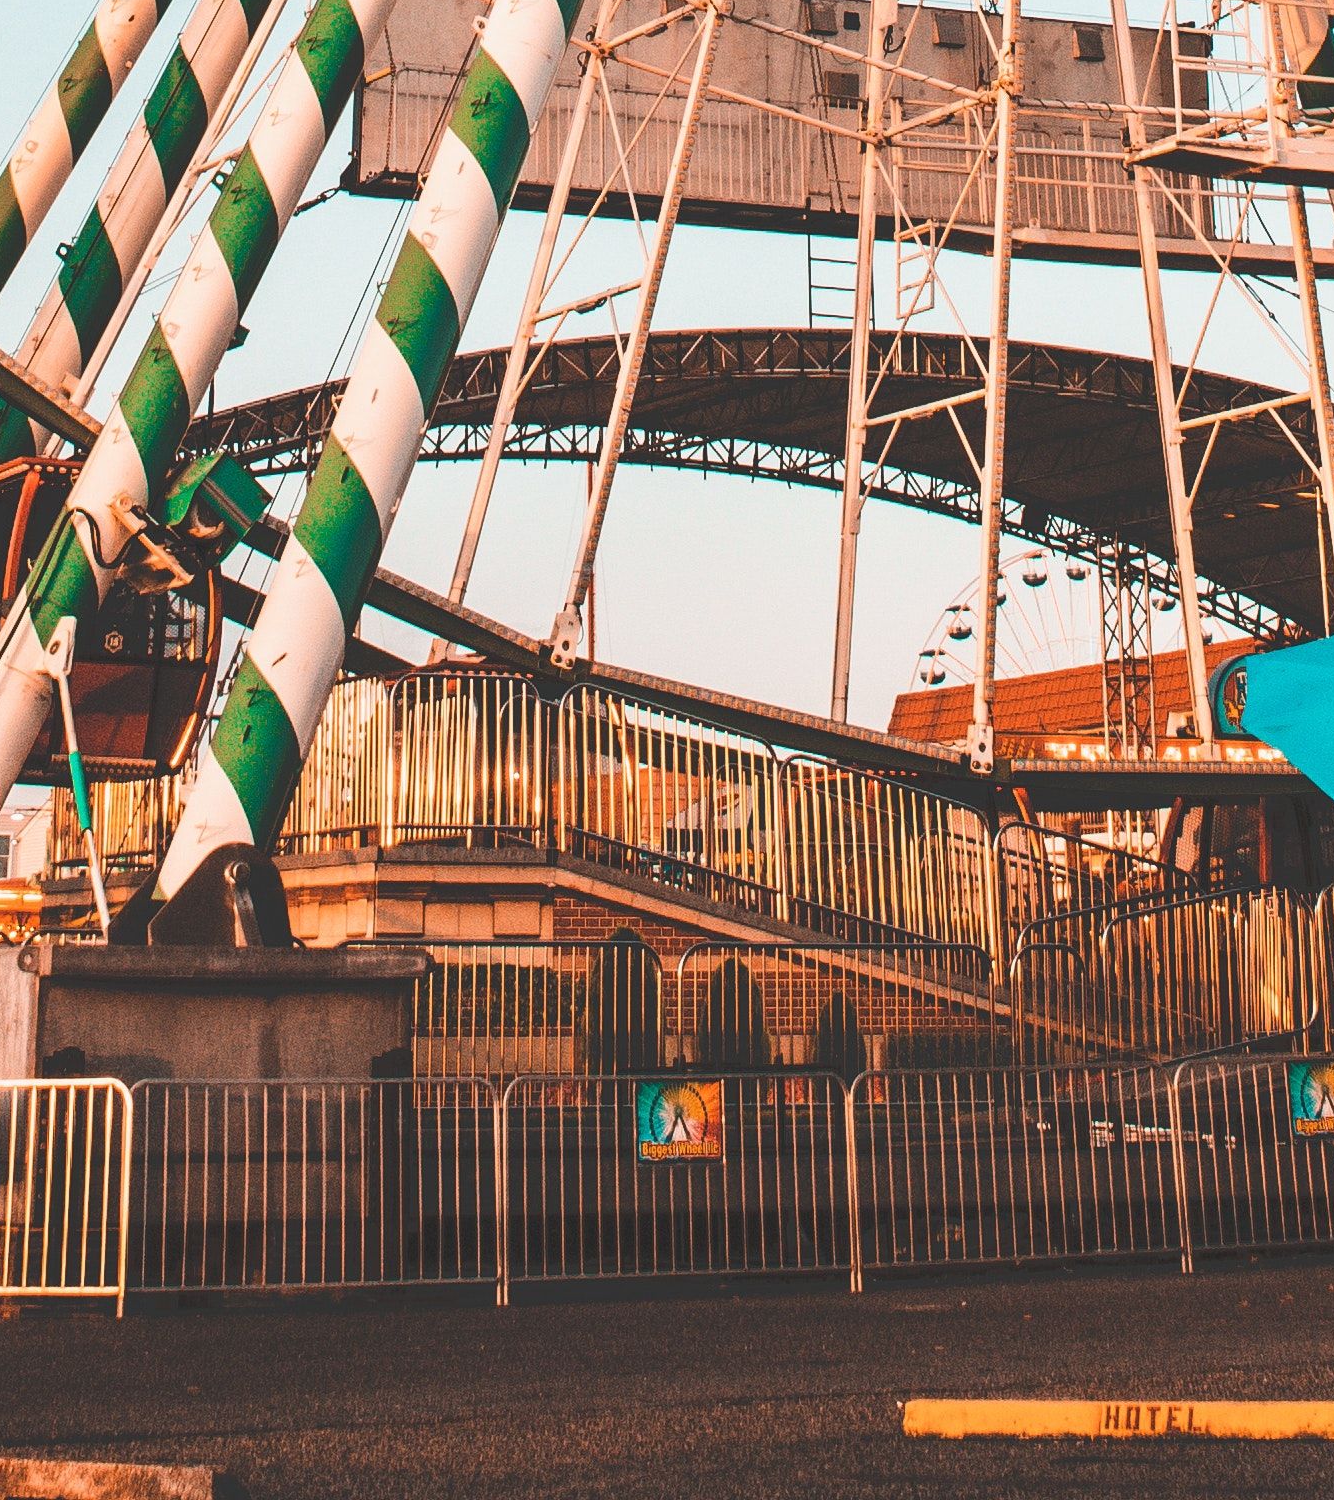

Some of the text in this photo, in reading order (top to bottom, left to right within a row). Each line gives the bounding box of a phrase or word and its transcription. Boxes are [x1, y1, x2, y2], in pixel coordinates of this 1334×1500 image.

[642, 1141, 677, 1159] Biggest
[677, 1141, 706, 1156] Wheel
[1105, 1405, 1202, 1431] HOTEL
